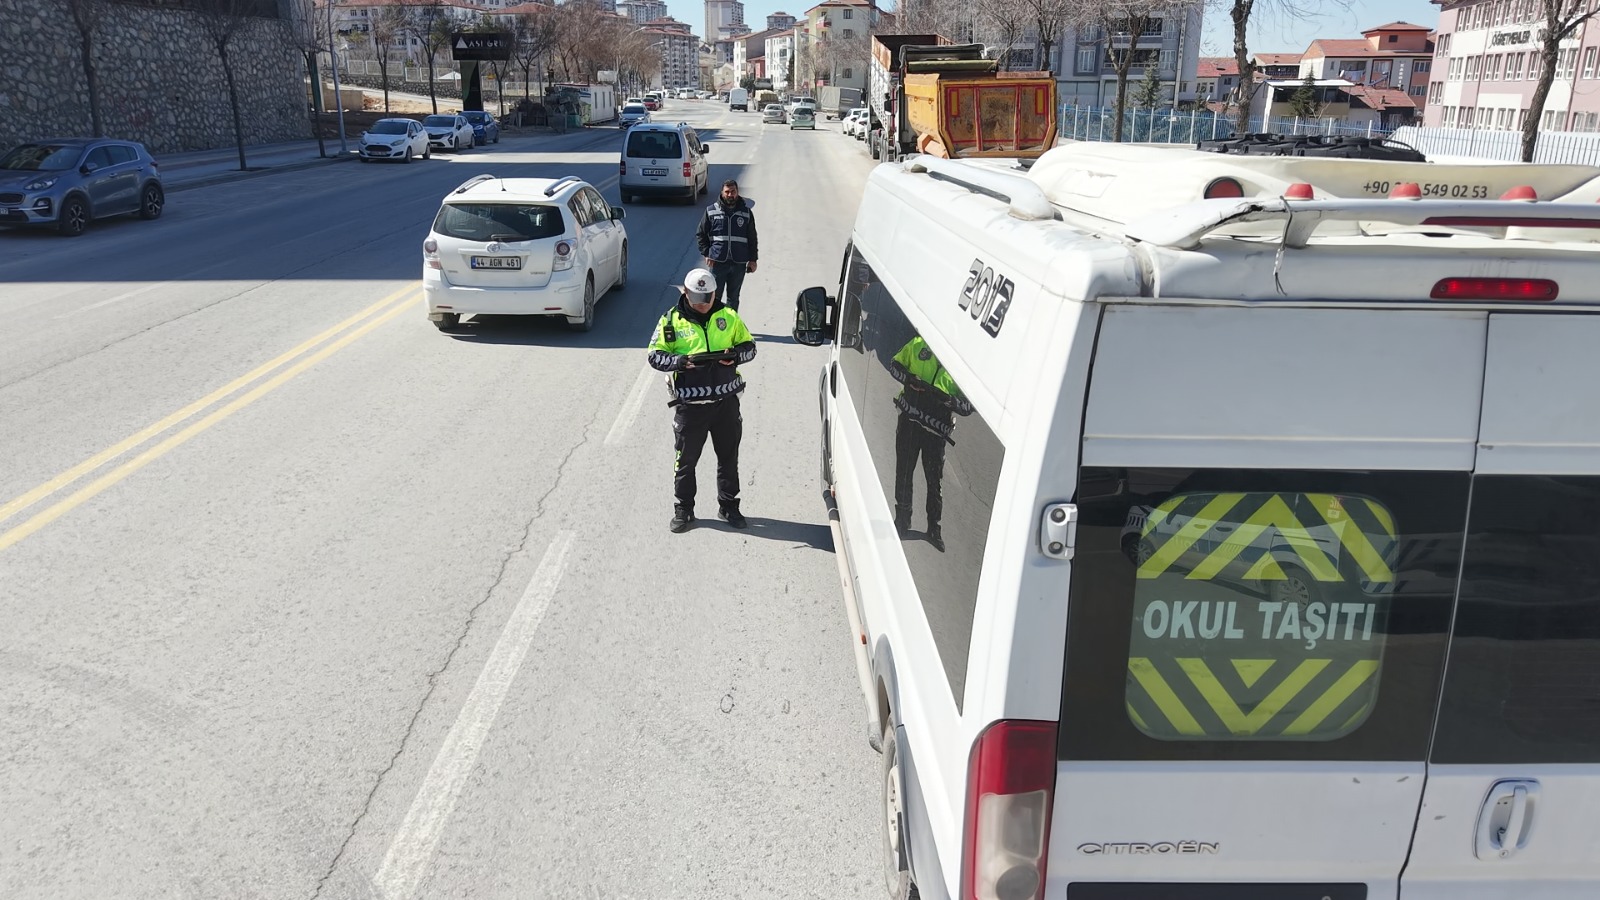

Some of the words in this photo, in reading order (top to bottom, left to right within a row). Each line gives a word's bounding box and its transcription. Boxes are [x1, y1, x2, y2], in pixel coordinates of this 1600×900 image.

[1363, 181, 1389, 194] +90
[1422, 183, 1448, 197] 549
[1451, 185, 1468, 198] 02
[1471, 185, 1488, 199] 53
[475, 258, 485, 267] 44
[489, 258, 503, 267] AGN
[506, 258, 519, 267] 461
[958, 258, 1015, 338] 2013
[1143, 600, 1244, 640] OKUL
[1258, 601, 1376, 650] TAŞITI
[1077, 840, 1220, 855] CITROËN
